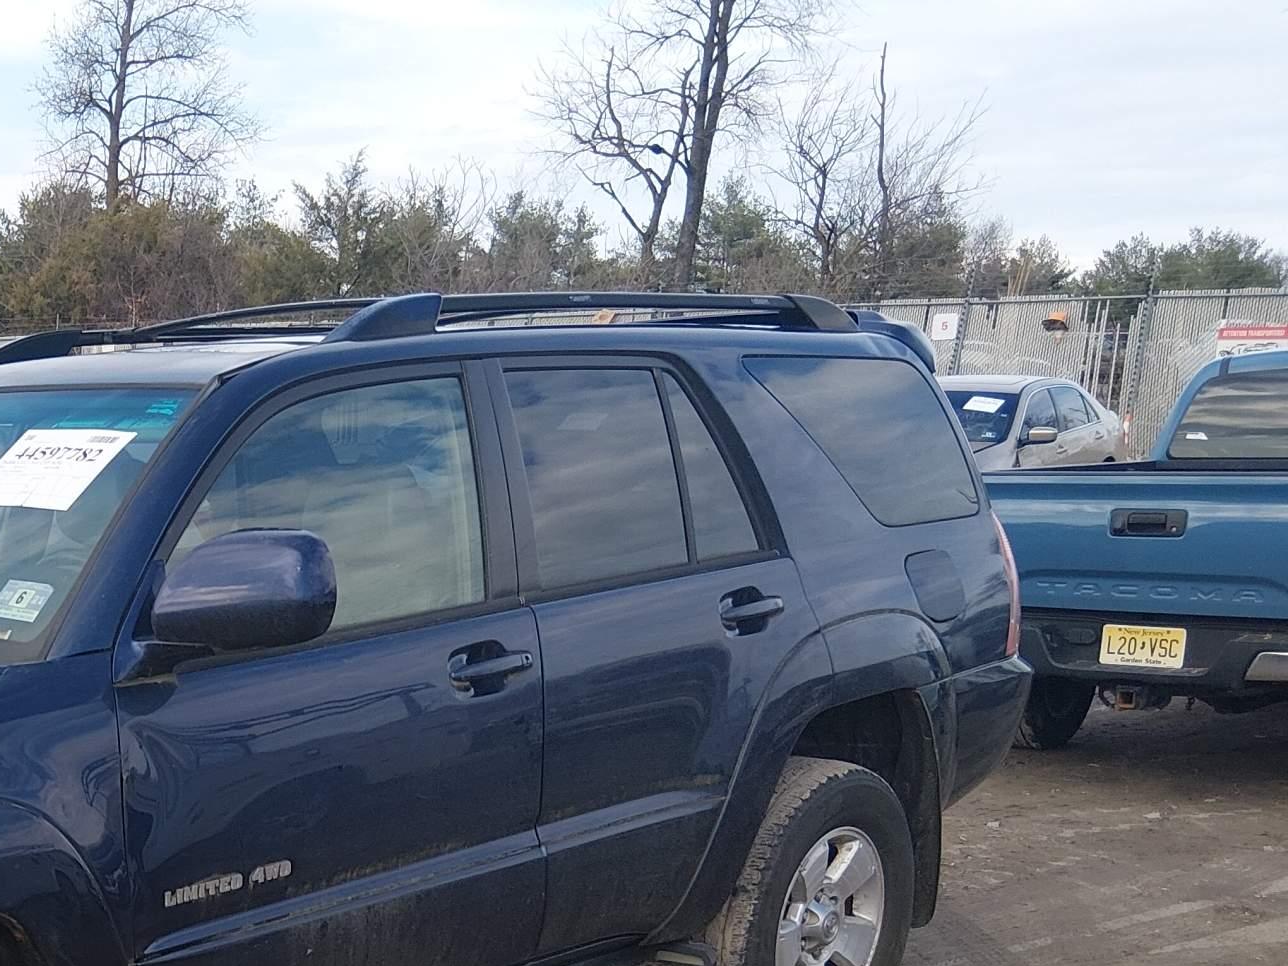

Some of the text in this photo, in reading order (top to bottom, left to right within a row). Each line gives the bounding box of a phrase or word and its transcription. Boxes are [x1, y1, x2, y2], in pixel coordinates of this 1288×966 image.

[941, 321, 948, 331] 5
[15, 447, 103, 462] 44597782
[15, 591, 27, 605] 6
[1036, 581, 1265, 604] TACOMA
[1142, 628, 1165, 637] Jersey
[1145, 657, 1162, 666] State
[164, 860, 292, 908] LIMITED 4WD
